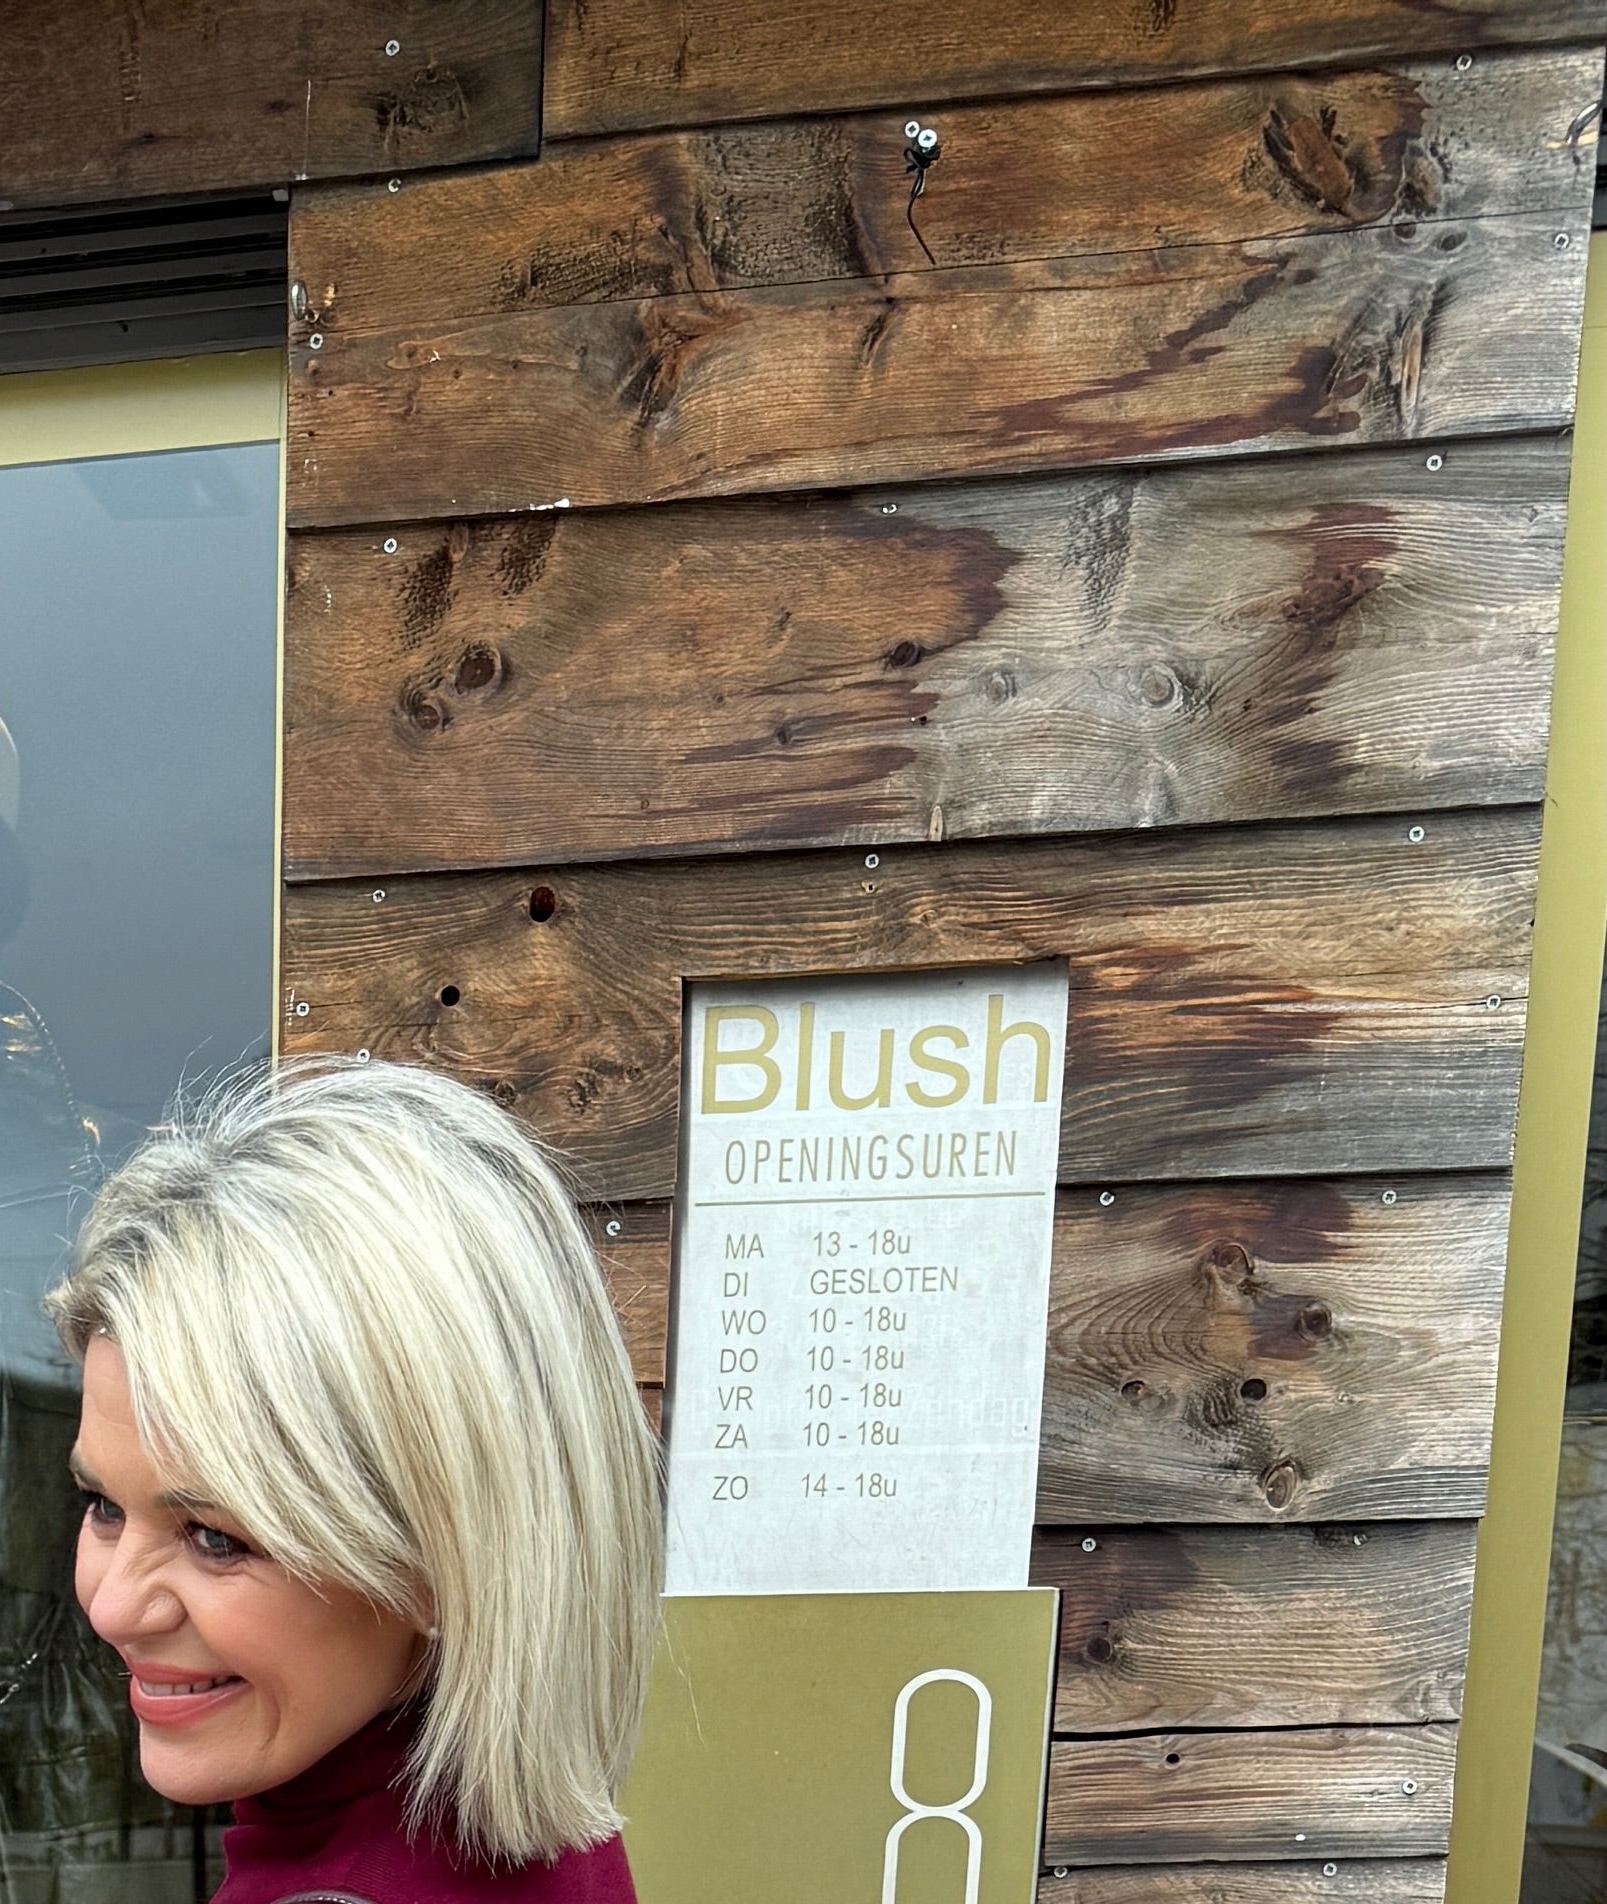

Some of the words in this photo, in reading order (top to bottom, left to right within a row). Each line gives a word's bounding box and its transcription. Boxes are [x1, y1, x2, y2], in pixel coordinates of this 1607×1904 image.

[700, 994, 1051, 1115] Blush
[725, 1130, 1017, 1185] OPENINGSUREN
[725, 1233, 765, 1260] MA
[813, 1230, 841, 1258] 13
[867, 1228, 911, 1256] 18u
[723, 1271, 749, 1298] DI
[810, 1265, 959, 1296] GESLOTEN
[721, 1309, 767, 1337] WO
[809, 1307, 837, 1334] 10
[863, 1305, 907, 1333] 18u
[719, 1347, 759, 1374] DO
[806, 1345, 835, 1372] 10
[861, 1344, 905, 1371] 18u
[717, 1385, 754, 1412] VR
[804, 1383, 833, 1411] 10
[859, 1382, 902, 1409] 18u
[714, 1423, 749, 1450] ZA
[802, 1421, 830, 1448] 10
[857, 1420, 900, 1446] 18u
[711, 1475, 749, 1501] ZO
[801, 1472, 828, 1499] 14
[855, 1472, 898, 1498] 18u
